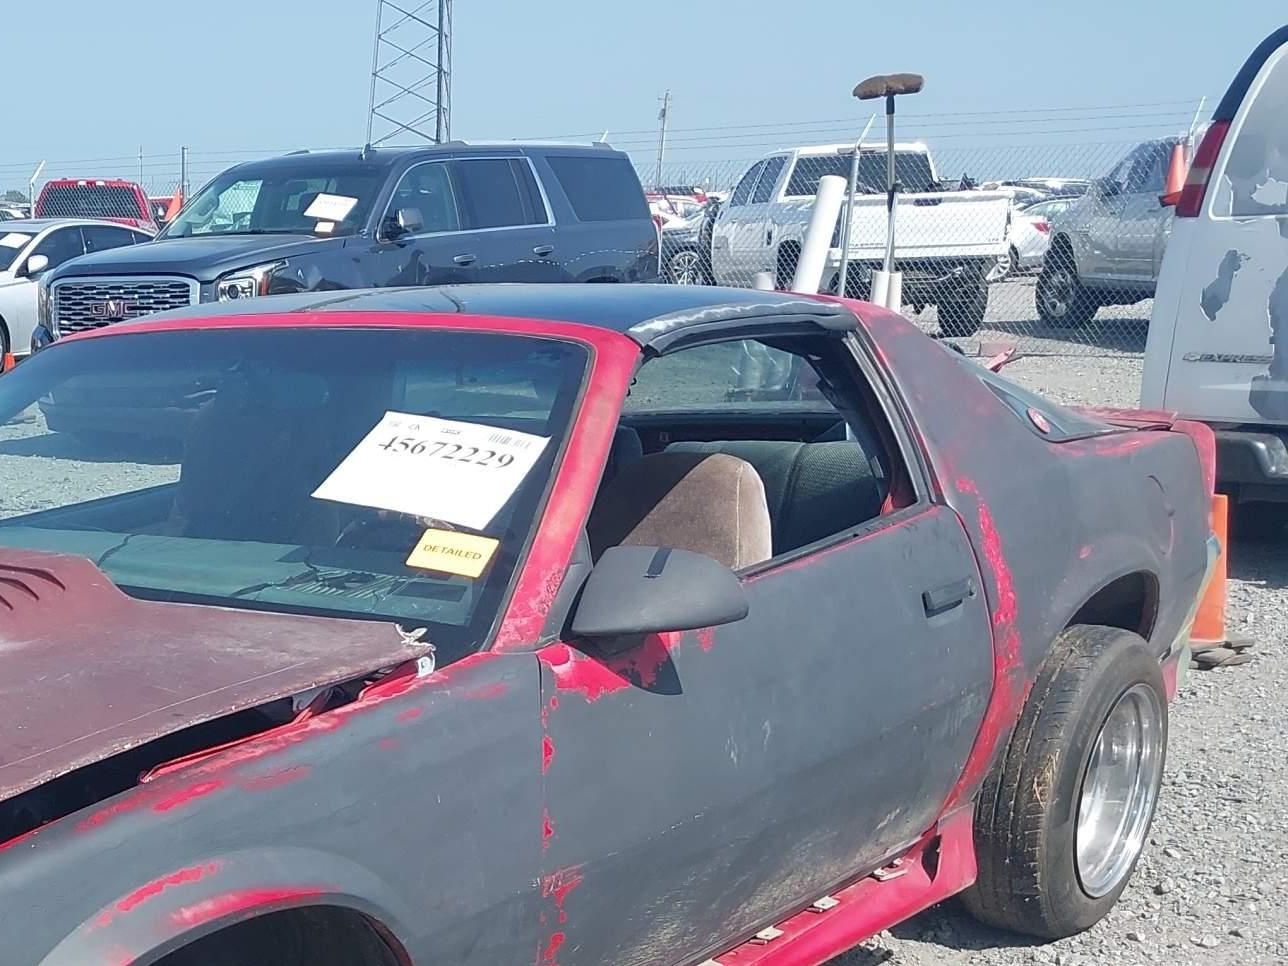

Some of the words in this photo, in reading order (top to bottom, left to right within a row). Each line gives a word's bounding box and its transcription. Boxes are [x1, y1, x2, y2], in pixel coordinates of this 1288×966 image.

[89, 299, 138, 317] GMC
[378, 435, 515, 469] 45672229
[423, 544, 482, 560] DETAILED
